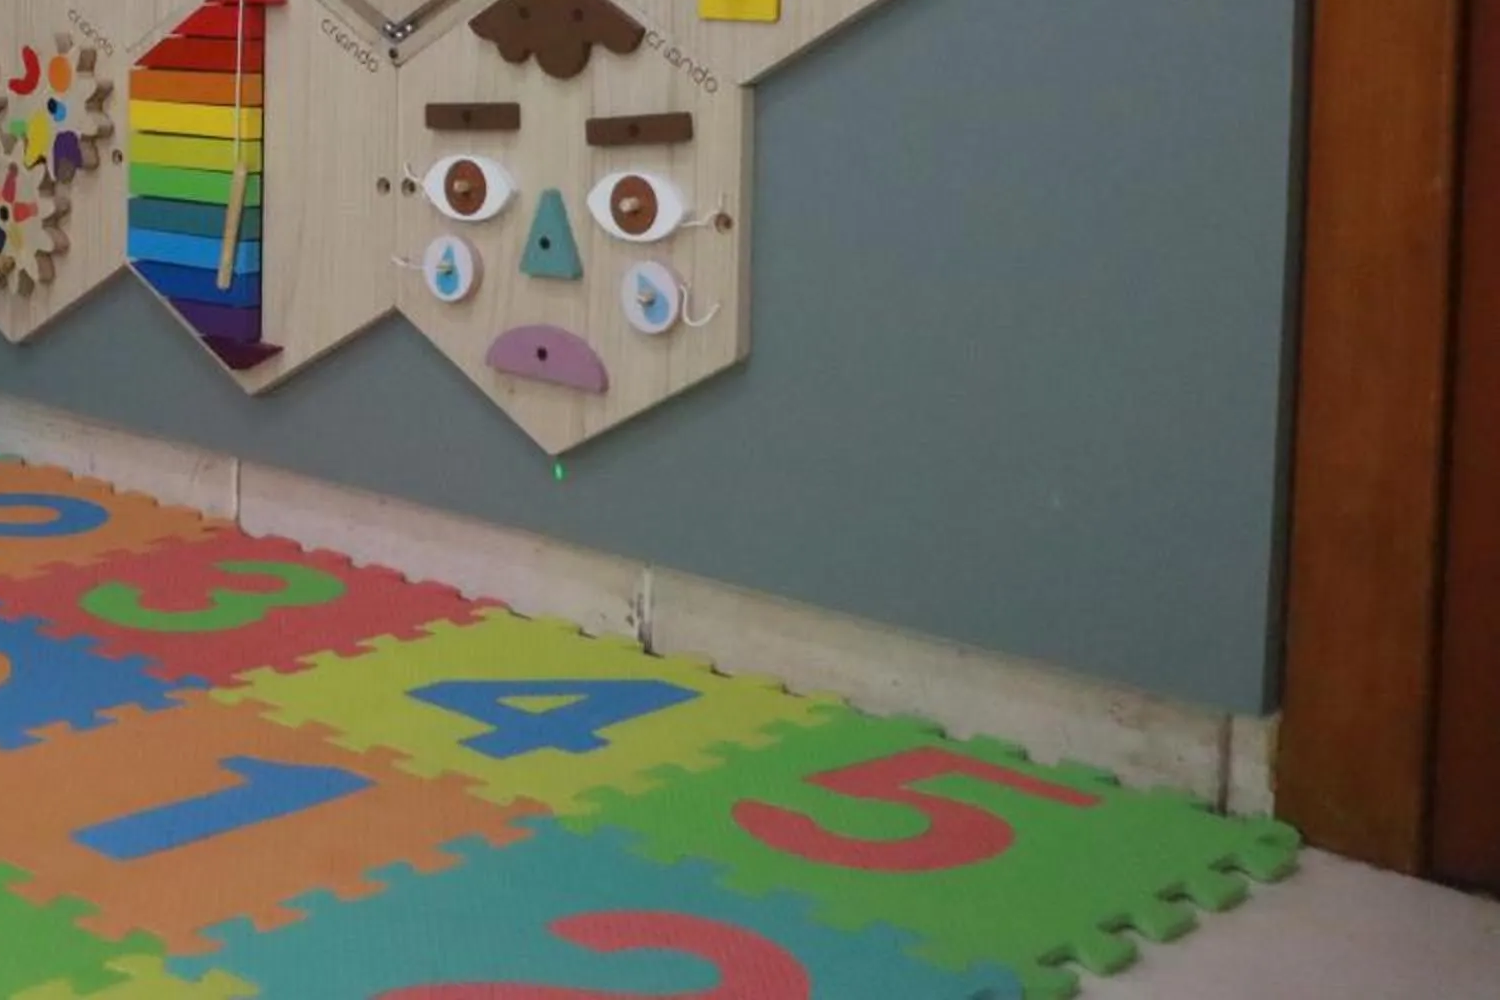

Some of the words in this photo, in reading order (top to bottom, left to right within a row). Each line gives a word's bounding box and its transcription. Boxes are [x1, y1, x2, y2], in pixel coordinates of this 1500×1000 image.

[66, 8, 115, 58] criando
[320, 17, 379, 74] criando
[645, 29, 719, 94] criando
[80, 560, 347, 632] 3
[405, 679, 700, 759] 4
[70, 756, 379, 861] 1
[732, 747, 1105, 872] 5
